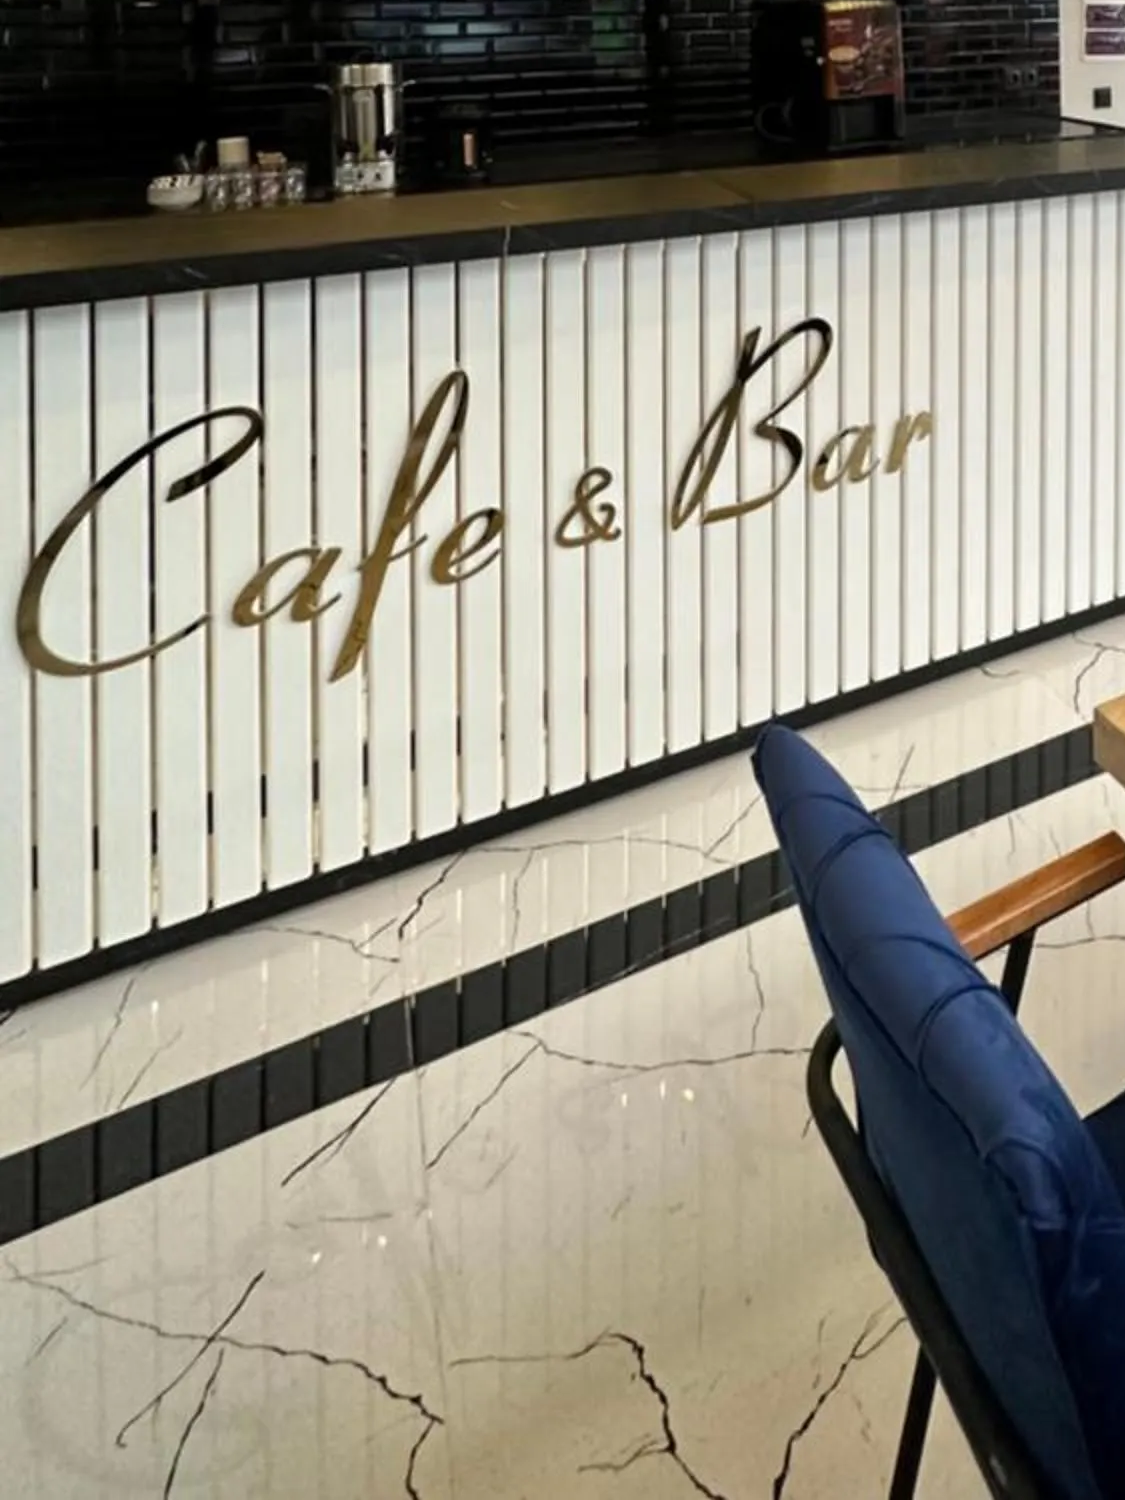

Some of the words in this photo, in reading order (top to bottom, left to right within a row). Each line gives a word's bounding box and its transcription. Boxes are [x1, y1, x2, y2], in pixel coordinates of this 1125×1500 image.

[16, 370, 505, 683] Cafe
[554, 467, 622, 549] &
[671, 317, 934, 530] Bar
